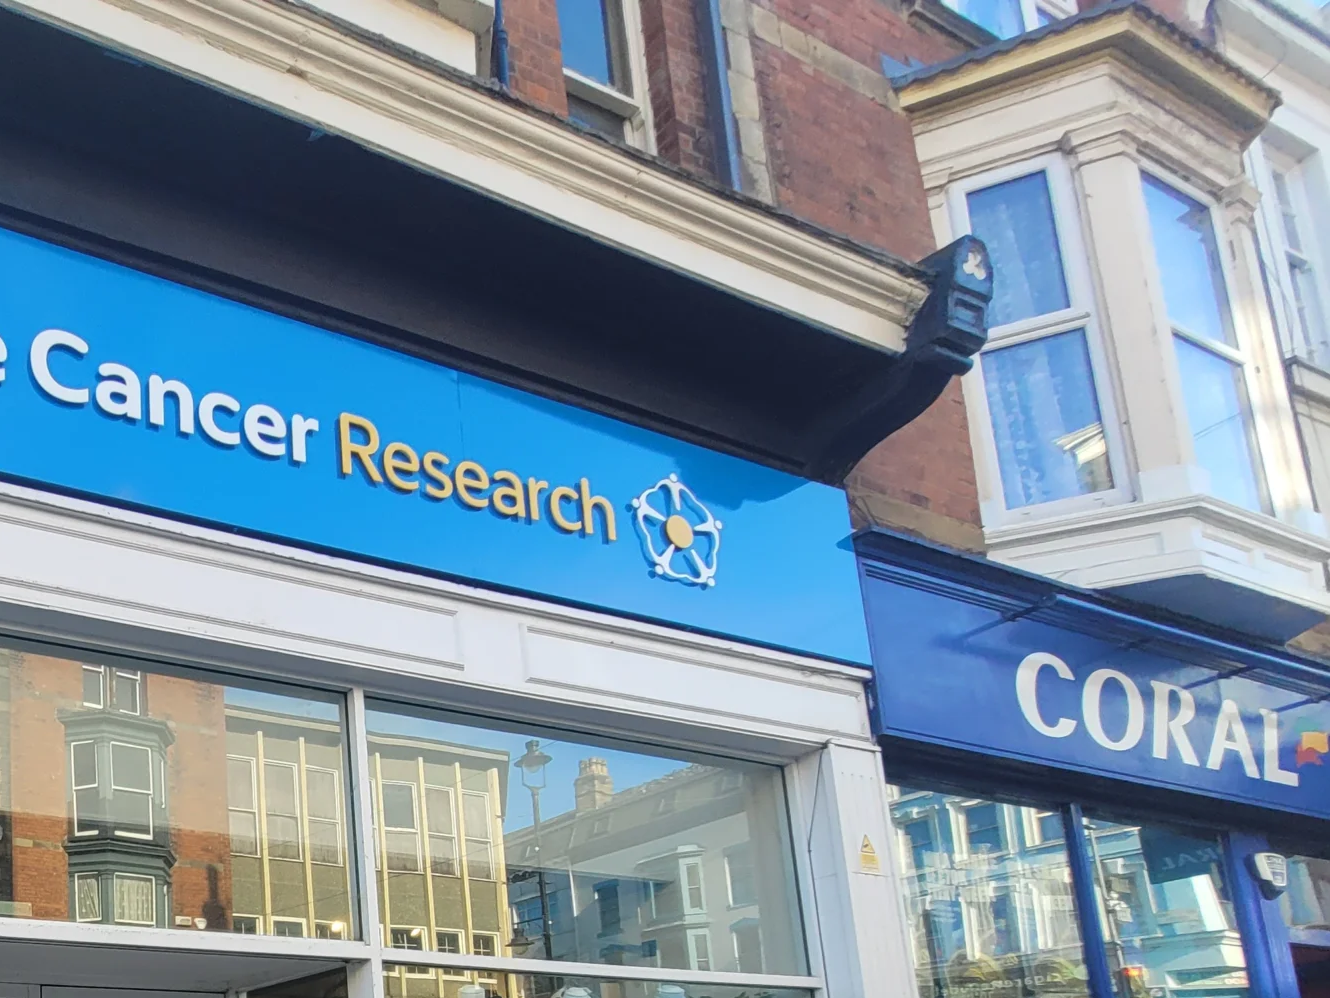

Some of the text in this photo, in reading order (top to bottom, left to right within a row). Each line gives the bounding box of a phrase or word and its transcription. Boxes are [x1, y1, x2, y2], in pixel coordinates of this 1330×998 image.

[29, 327, 319, 464] Cancer
[336, 411, 617, 542] Research
[1016, 652, 1299, 787] CORAL
